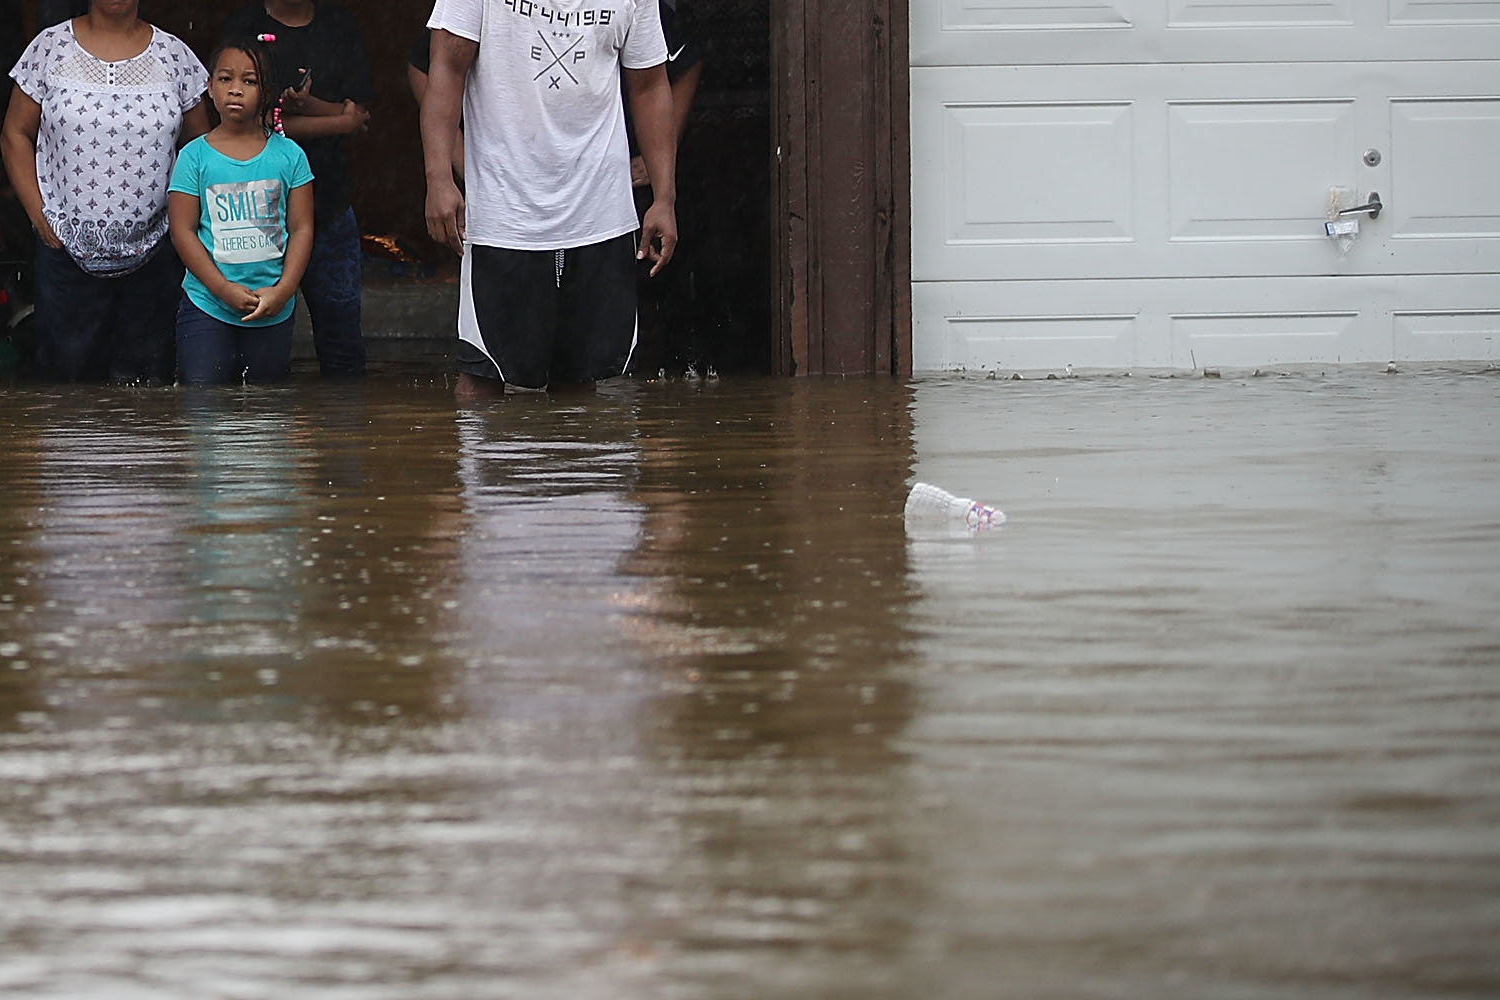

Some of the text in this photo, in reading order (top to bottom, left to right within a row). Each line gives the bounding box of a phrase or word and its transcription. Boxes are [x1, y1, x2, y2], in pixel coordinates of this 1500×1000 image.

[530, 45, 585, 64] E P
[215, 188, 277, 222] SMILE
[221, 235, 257, 252] THERE'S
